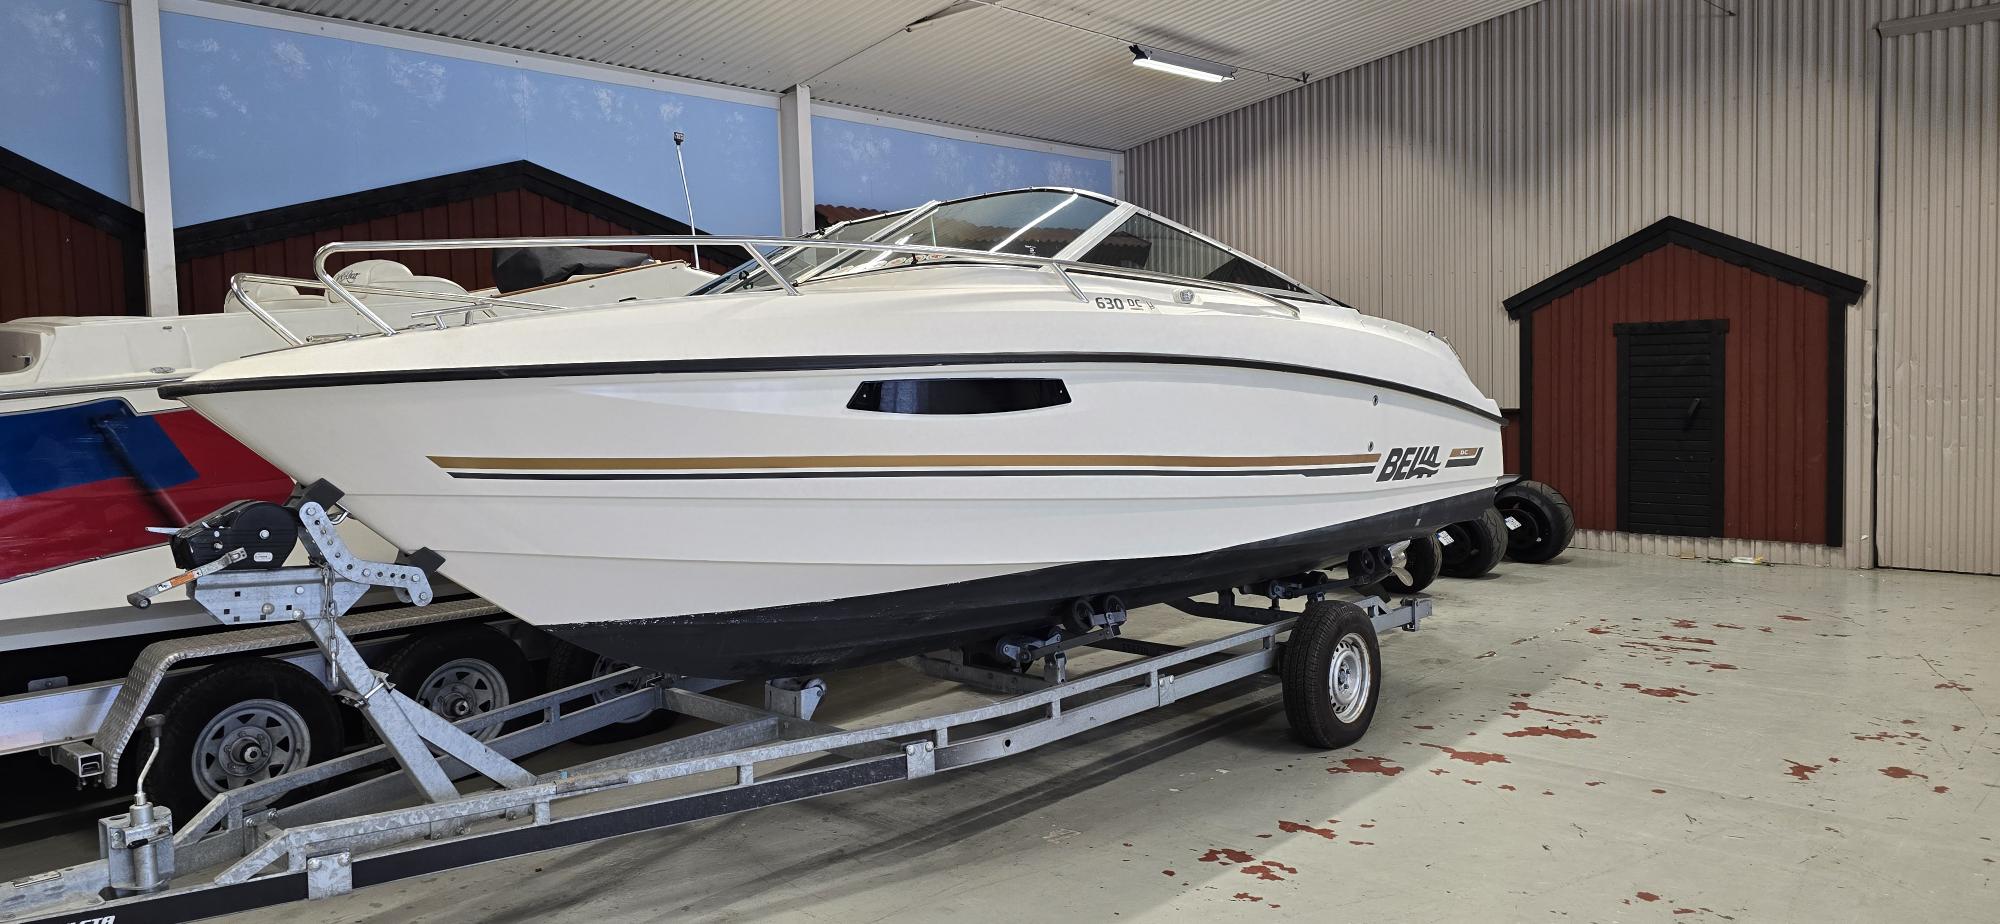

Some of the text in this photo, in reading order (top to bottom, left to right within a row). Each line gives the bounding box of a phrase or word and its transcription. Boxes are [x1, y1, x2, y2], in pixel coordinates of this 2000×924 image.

[1095, 297, 1125, 310] 630
[1126, 298, 1143, 308] DC
[1376, 446, 1441, 482] BELLA
